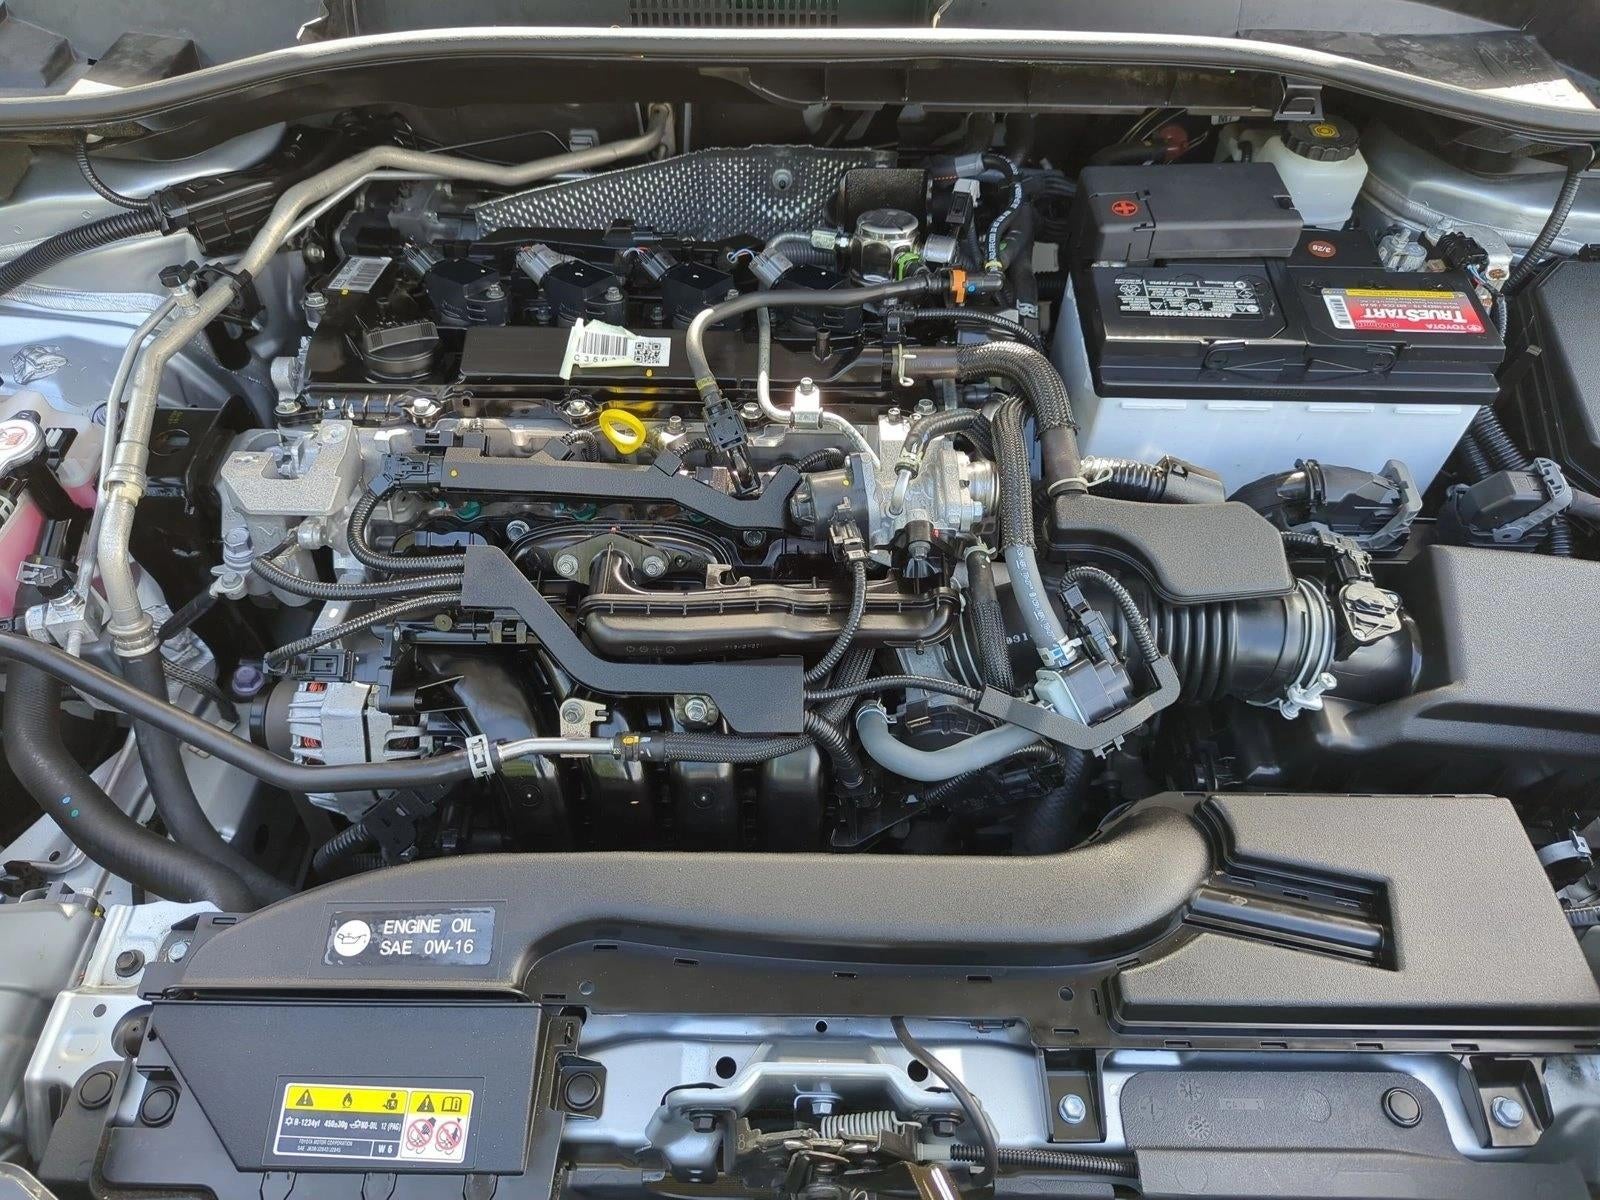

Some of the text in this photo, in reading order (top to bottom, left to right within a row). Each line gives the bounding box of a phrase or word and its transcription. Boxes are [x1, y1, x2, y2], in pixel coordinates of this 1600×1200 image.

[384, 918, 476, 934] ENGINE OIL
[379, 939, 474, 955] SAE 0W-16
[378, 1144, 393, 1154] W 6
